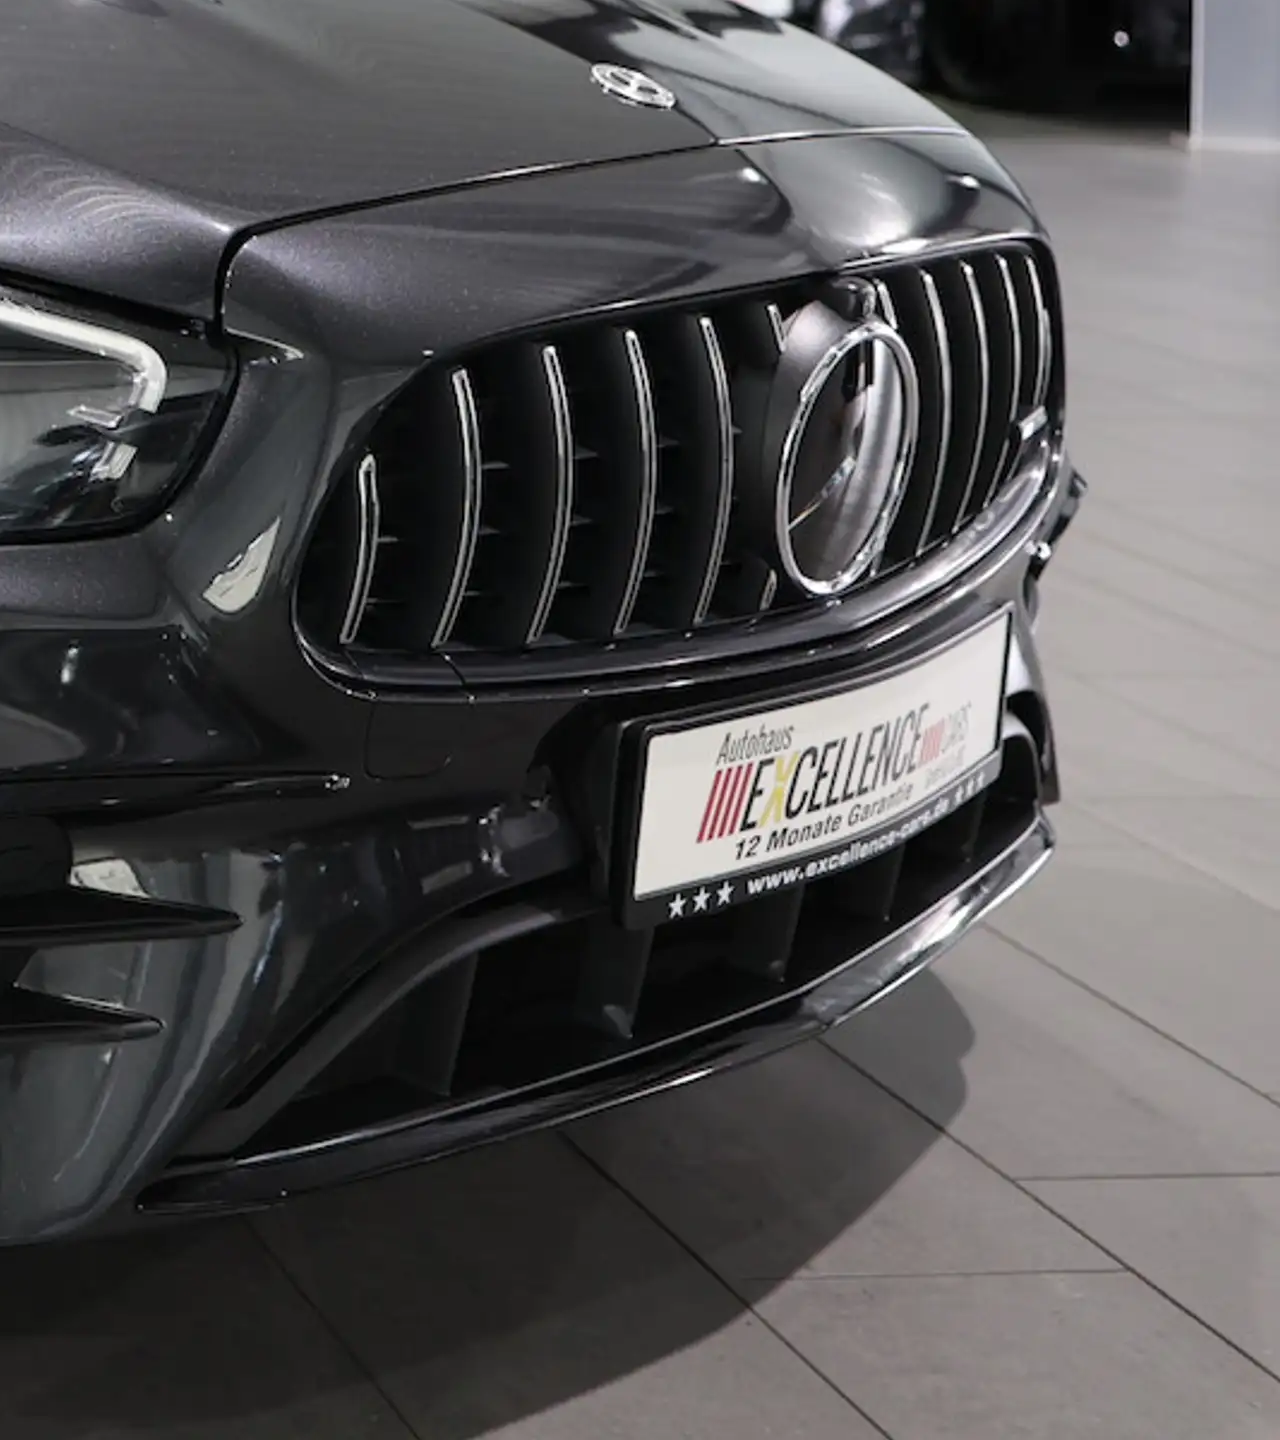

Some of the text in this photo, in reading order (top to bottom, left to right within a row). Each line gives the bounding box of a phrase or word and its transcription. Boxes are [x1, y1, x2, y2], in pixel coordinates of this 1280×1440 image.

[716, 723, 795, 766] Autohaus
[739, 702, 931, 832] EXCELLENCE
[735, 781, 914, 861] 12 Monate Garantie
[747, 797, 950, 895] www.excellence-cars.de
